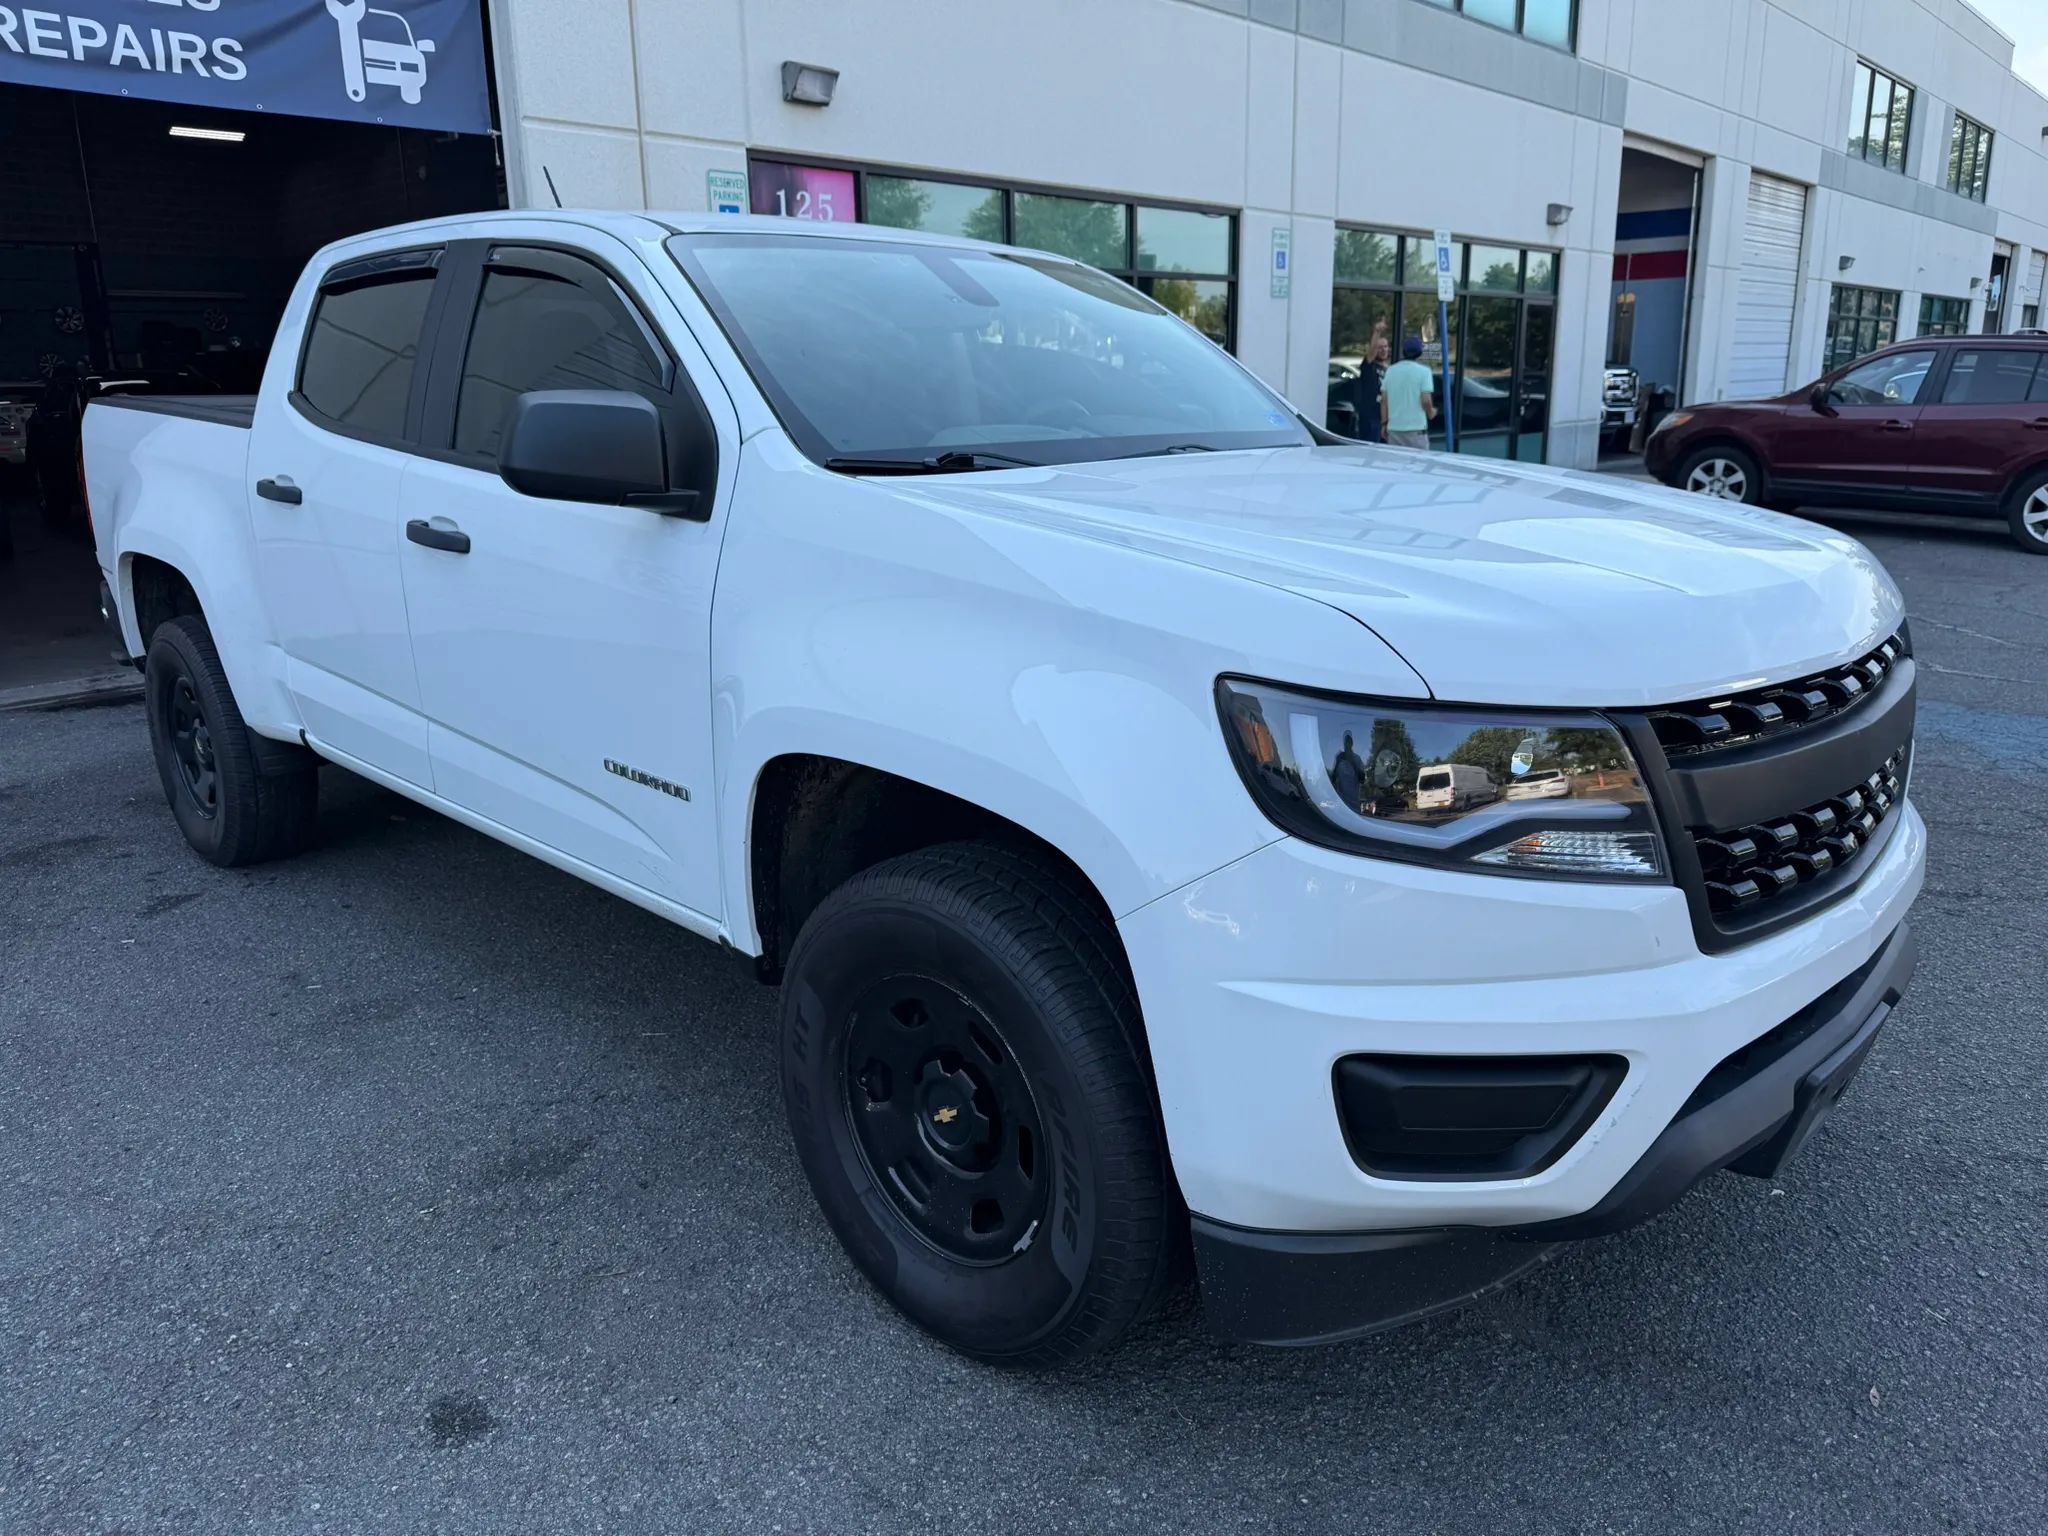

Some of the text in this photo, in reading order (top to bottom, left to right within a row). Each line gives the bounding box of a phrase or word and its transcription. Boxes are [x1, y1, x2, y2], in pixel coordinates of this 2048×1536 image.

[0, 5, 247, 81] REPAIRS
[709, 176, 745, 190] RESERVED
[713, 190, 744, 202] PARKING
[776, 188, 833, 221] 125
[603, 758, 691, 802] COLORADO
